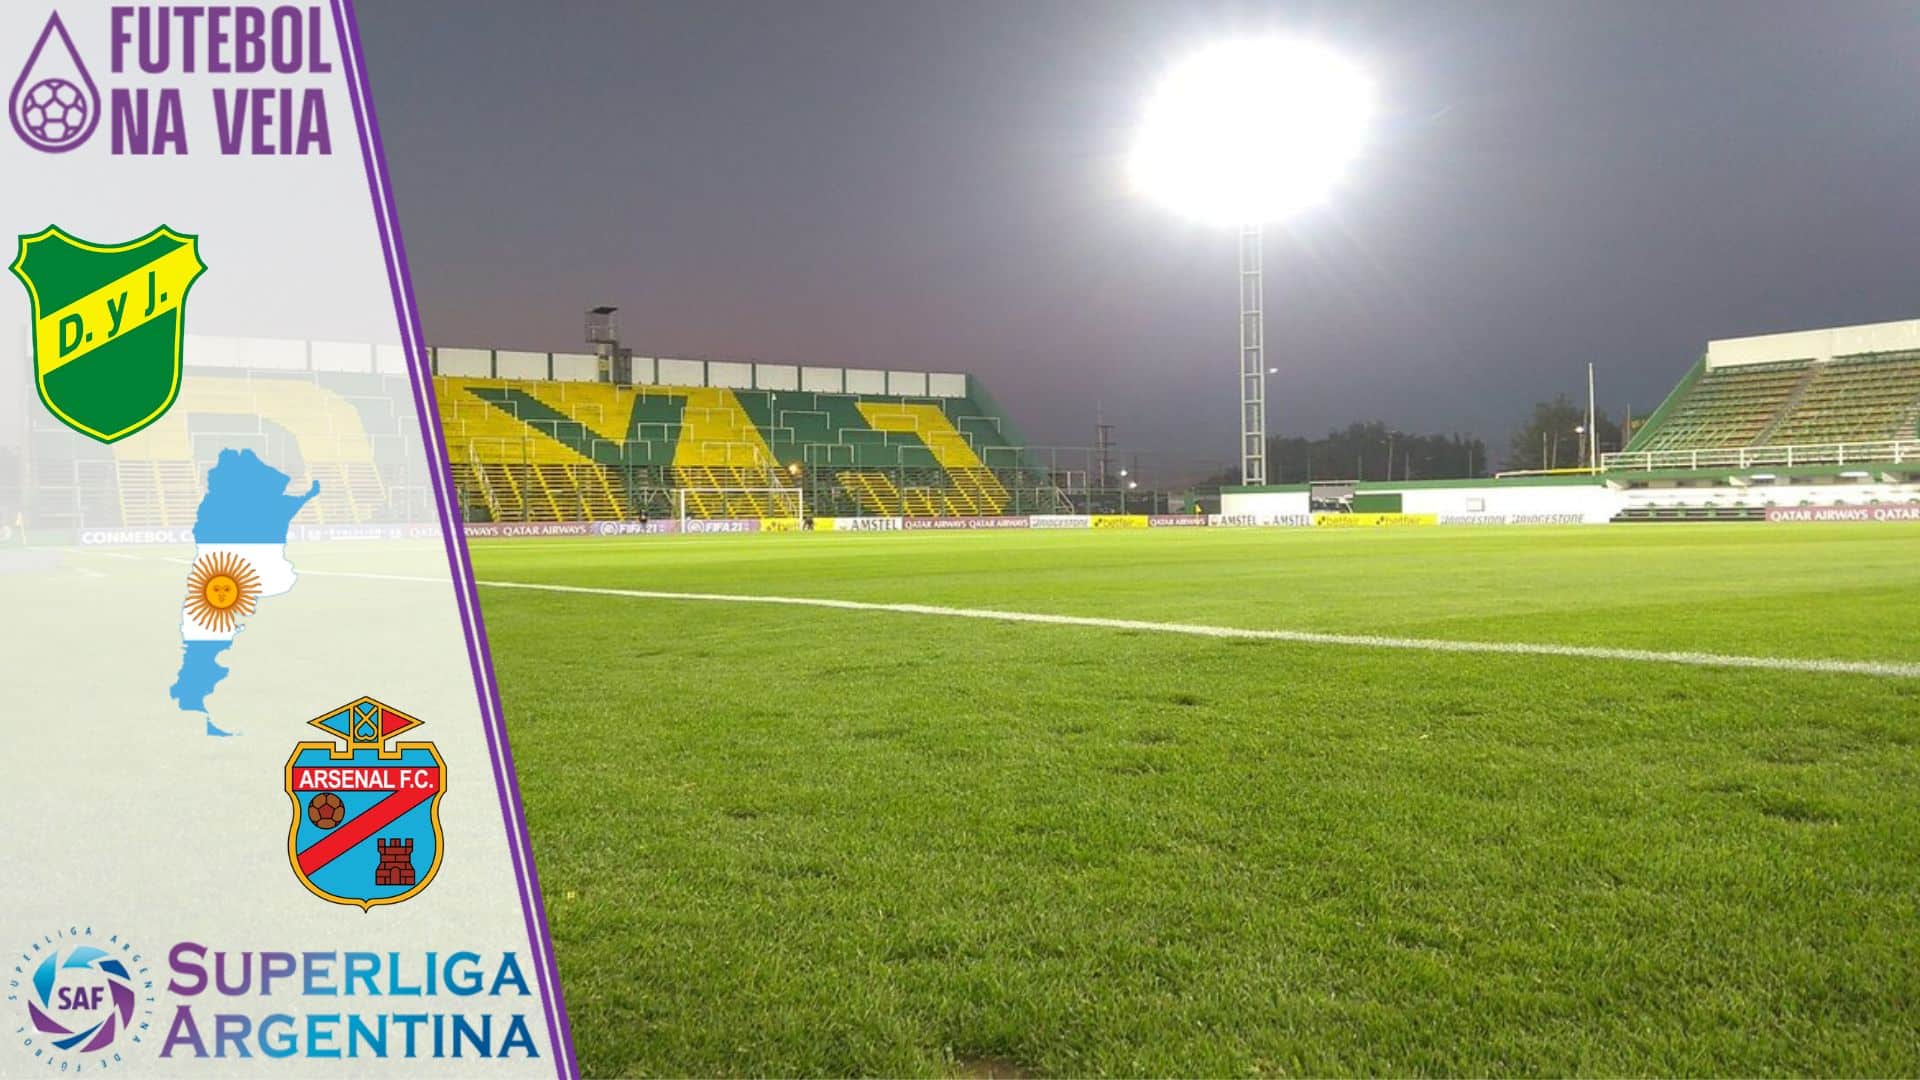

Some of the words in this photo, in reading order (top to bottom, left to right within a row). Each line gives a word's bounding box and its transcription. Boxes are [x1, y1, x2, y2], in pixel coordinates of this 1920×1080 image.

[1221, 515, 1256, 526] AMSTEL
[1273, 514, 1310, 526] AMSTEL
[1770, 510, 1811, 522] QATAR
[1815, 509, 1868, 520] AIRWAYS
[1874, 508, 1920, 522] QATAR
[704, 521, 730, 532] FIFA
[851, 519, 898, 531] AMSTEL
[905, 521, 934, 530] QATAR
[934, 520, 968, 529] AIRWAYS
[969, 519, 998, 529] QATAR
[81, 530, 177, 544] CONMEBOL
[503, 526, 540, 537] QATAR
[542, 525, 586, 536] AIRWAYS
